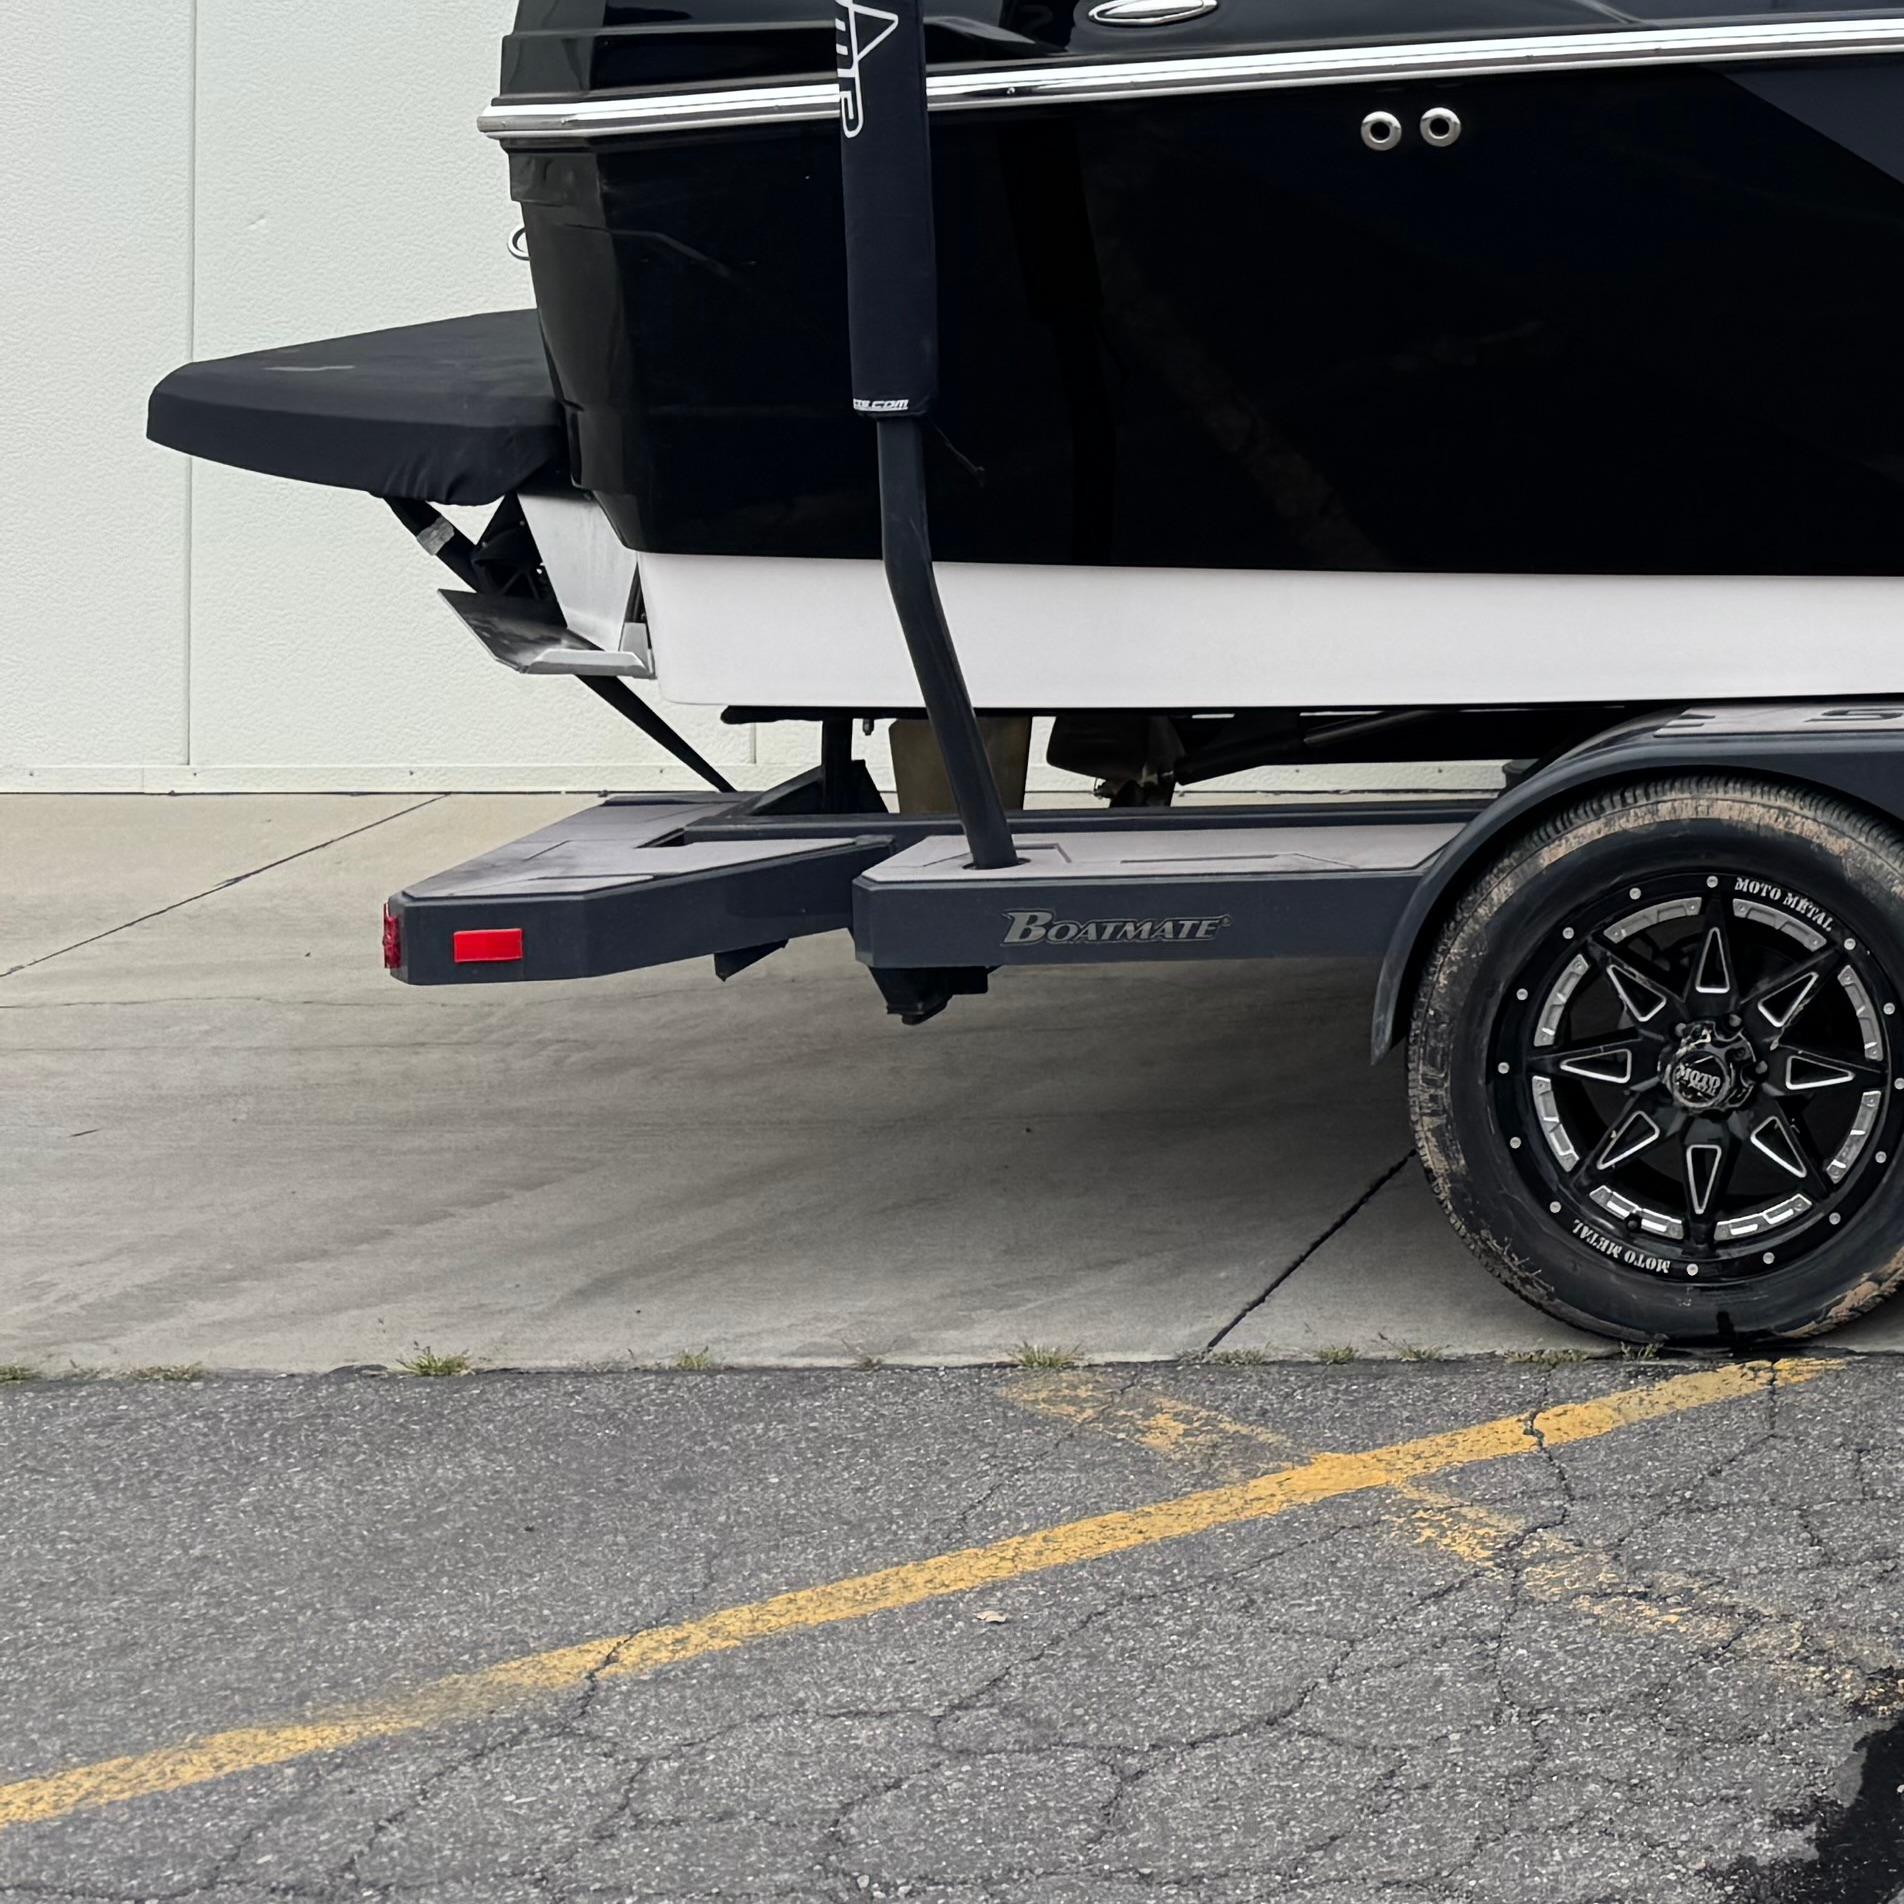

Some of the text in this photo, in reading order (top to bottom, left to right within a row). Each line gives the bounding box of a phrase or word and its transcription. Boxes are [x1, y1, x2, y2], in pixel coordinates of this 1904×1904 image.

[1734, 877, 1834, 932] MOTO METAL
[1572, 1219, 1671, 1274] MOTO METAL
